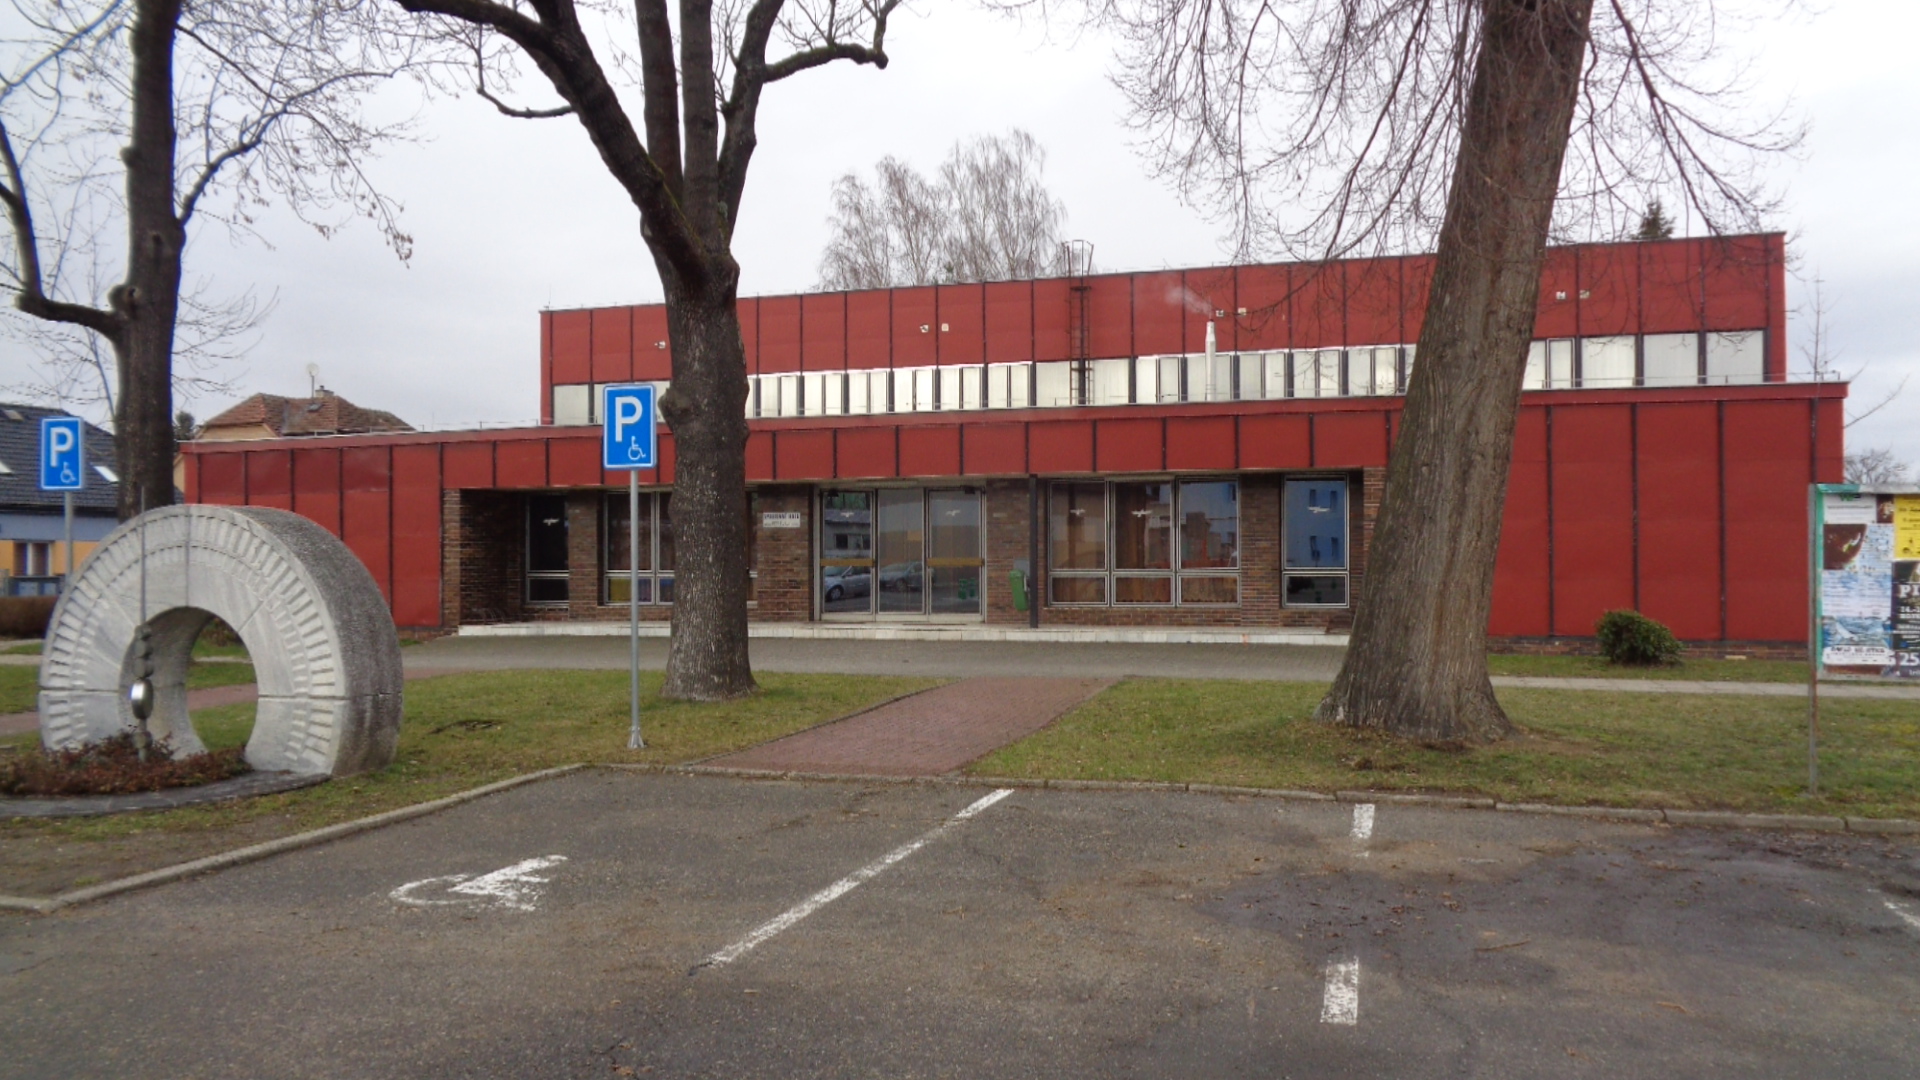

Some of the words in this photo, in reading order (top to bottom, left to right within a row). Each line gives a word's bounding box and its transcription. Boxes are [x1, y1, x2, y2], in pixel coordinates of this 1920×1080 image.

[615, 396, 643, 442] P
[49, 426, 74, 467] P
[1899, 584, 1920, 598] PI
